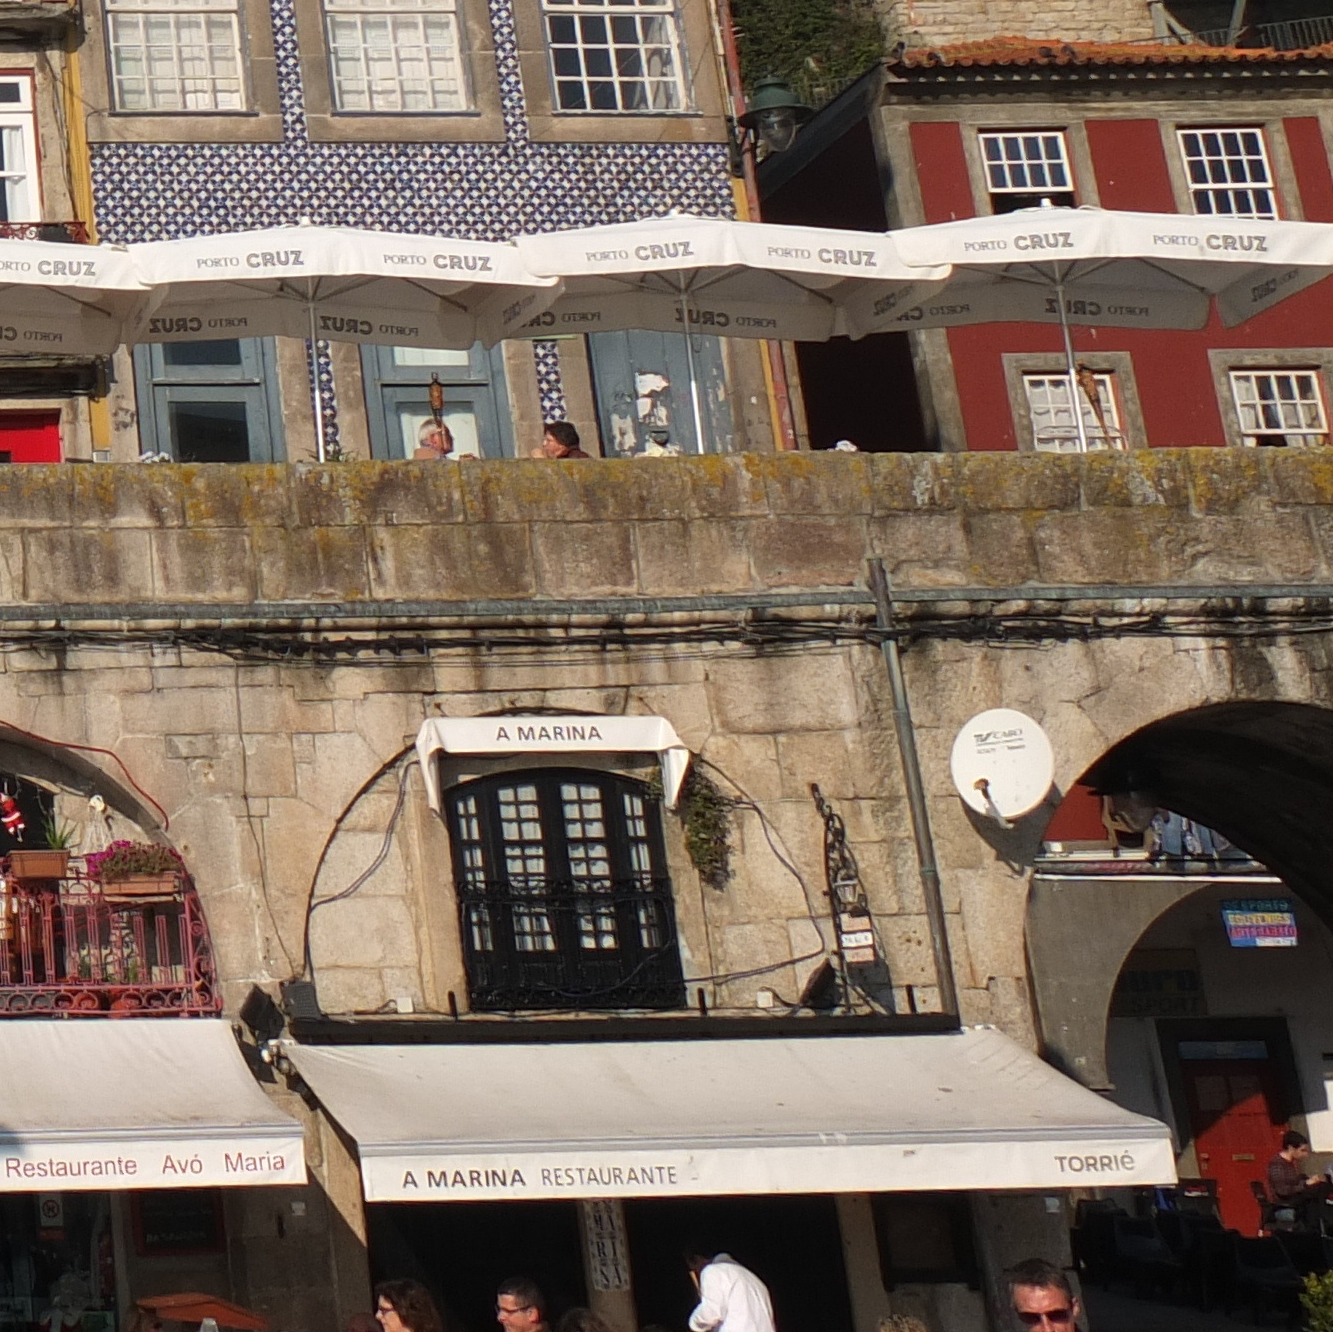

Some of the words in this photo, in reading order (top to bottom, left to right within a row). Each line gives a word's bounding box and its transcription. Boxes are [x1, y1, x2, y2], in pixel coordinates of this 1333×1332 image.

[585, 249, 628, 262] PORTO
[634, 241, 694, 261] CRUZ
[964, 240, 1007, 252] PORTO
[1014, 232, 1074, 251] CRUZ
[1153, 234, 1198, 247] PORTO
[1206, 234, 1267, 252] CRUZ
[197, 257, 239, 268] PORTO
[246, 250, 304, 269] CRUZ
[383, 253, 426, 266] PORTO
[433, 254, 493, 272] CRUZ
[767, 246, 811, 259] PORTO
[818, 247, 877, 267] CRUZ
[37, 260, 95, 277] CRUZ
[496, 726, 510, 740] A
[517, 726, 603, 740] MARINA
[5, 1157, 137, 1178] Restaurante
[162, 1154, 203, 1174] Avó
[224, 1151, 285, 1172] Maria
[402, 1170, 418, 1188] A
[428, 1169, 526, 1188] MARINA
[541, 1166, 677, 1186] RESTAURANTE
